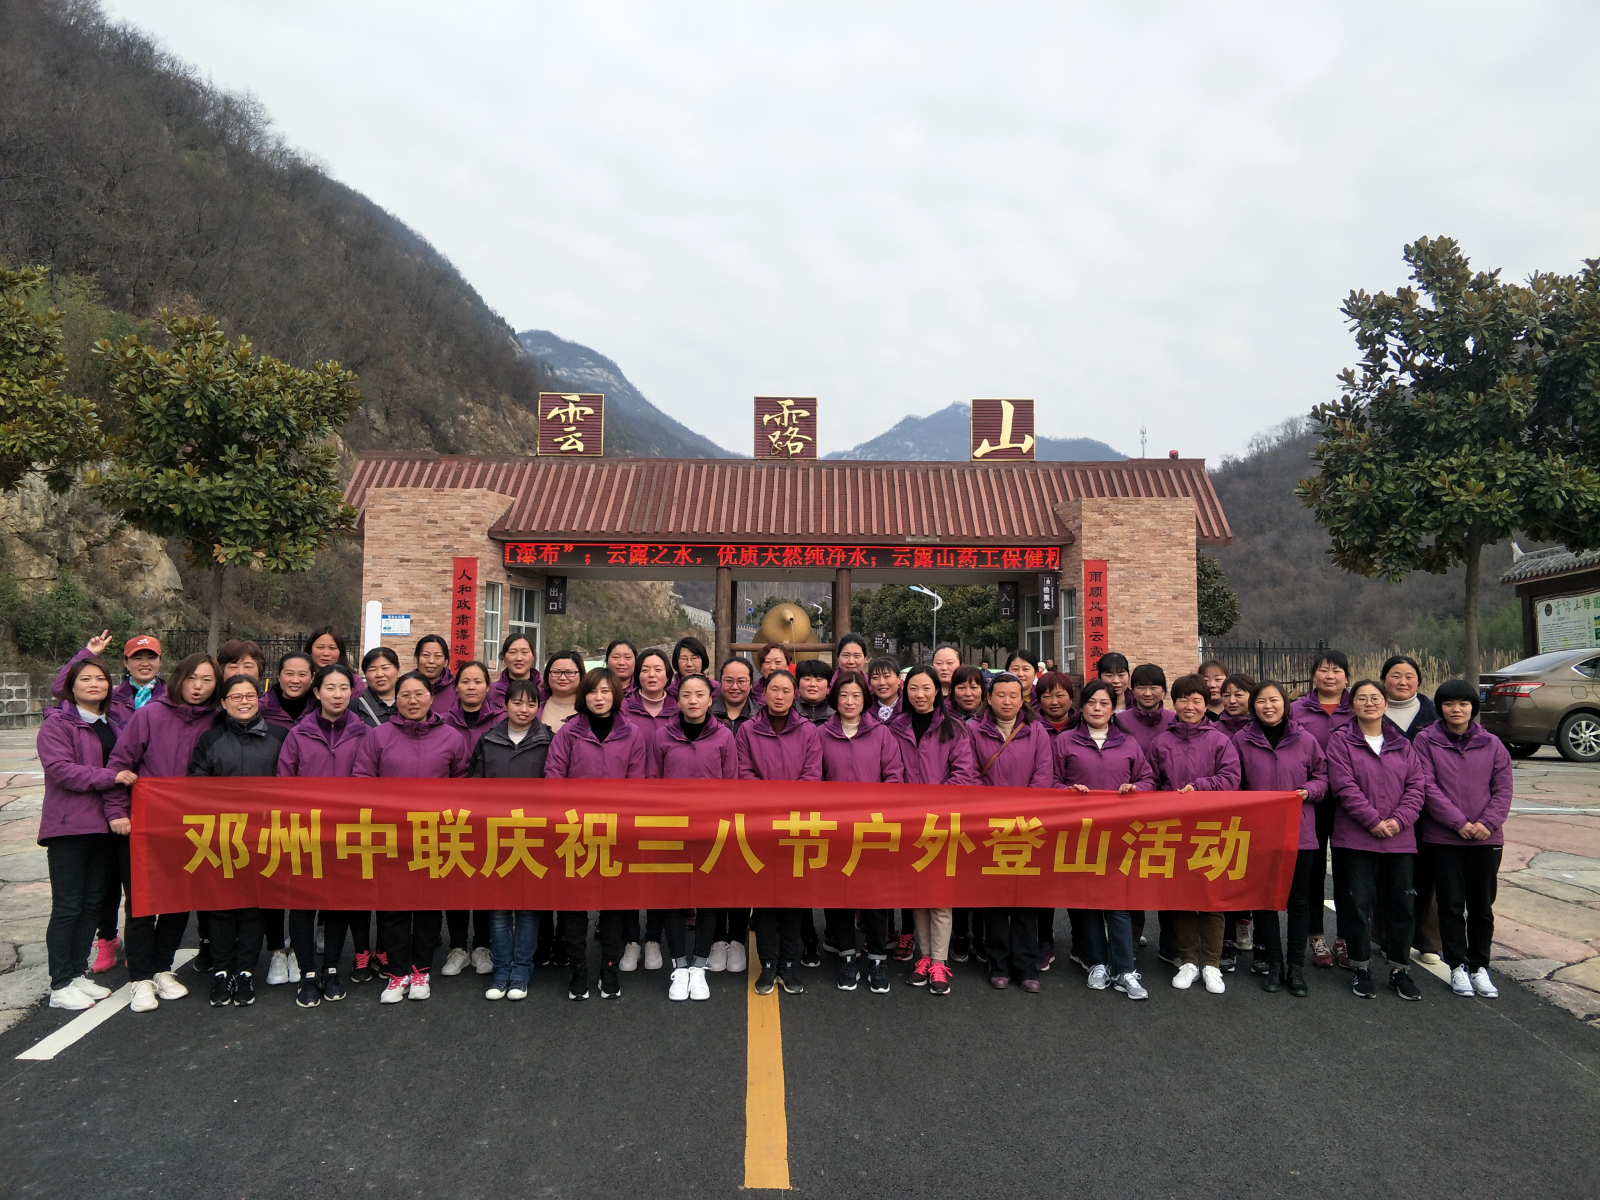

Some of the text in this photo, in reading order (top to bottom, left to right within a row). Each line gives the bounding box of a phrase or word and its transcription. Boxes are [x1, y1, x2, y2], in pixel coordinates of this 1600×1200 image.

[973, 400, 1034, 458] 山
[550, 587, 558, 610] 出口
[1001, 593, 1010, 615] 入口
[183, 808, 1251, 881] 邓州中联庆祝三八节户外登山活动
